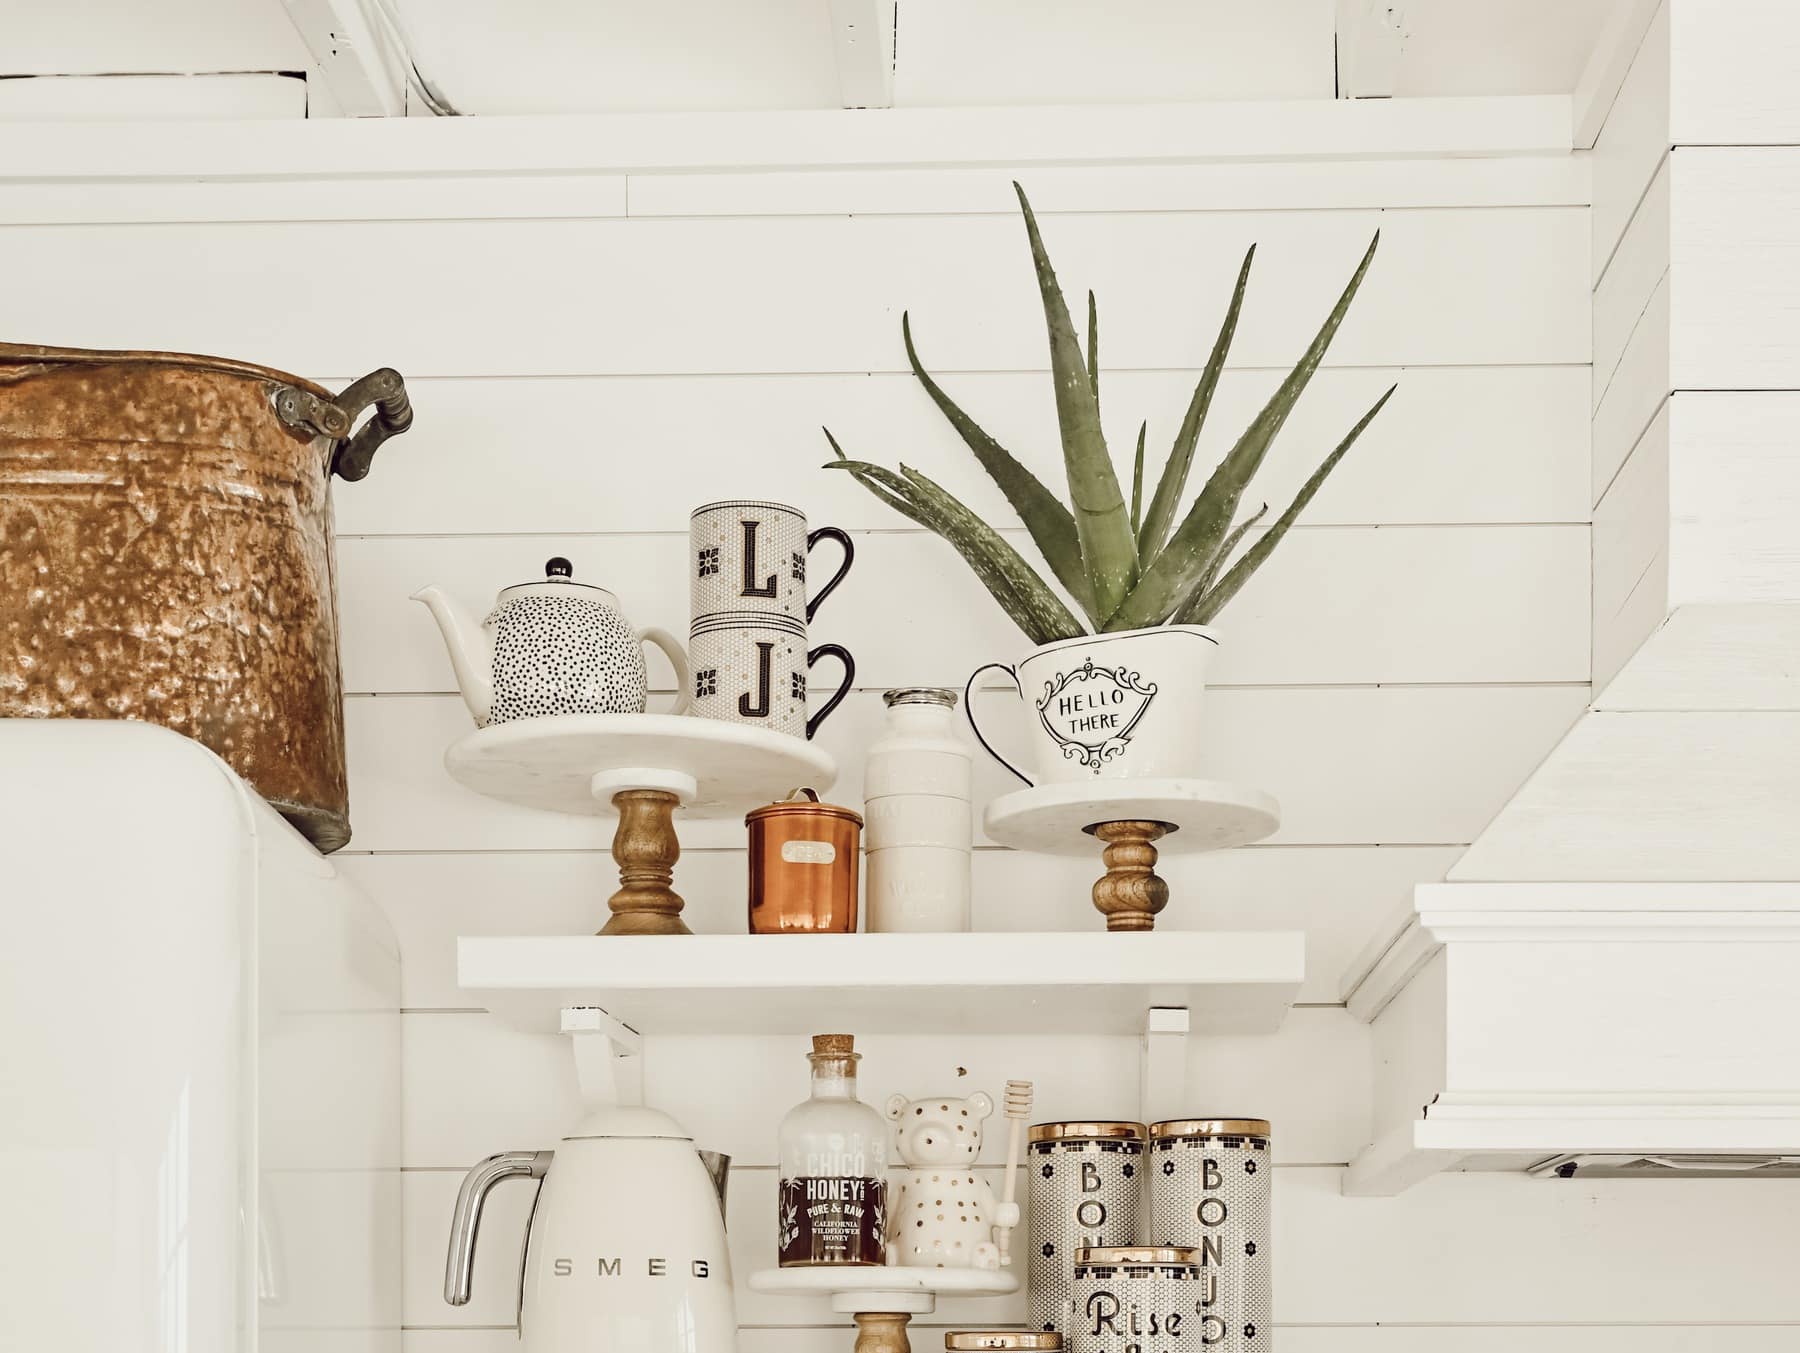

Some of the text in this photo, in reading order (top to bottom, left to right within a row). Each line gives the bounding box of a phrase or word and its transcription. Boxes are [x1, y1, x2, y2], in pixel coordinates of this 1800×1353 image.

[740, 521, 777, 597] L
[738, 642, 774, 717] J
[1058, 689, 1124, 716] HELLO
[1068, 713, 1120, 734] THERE
[807, 1153, 864, 1178] CHICO
[807, 1179, 860, 1200] HONEY
[806, 1203, 865, 1218] PURE & RAW
[554, 1258, 709, 1278] SMEG
[1086, 1290, 1182, 1337] Rise
